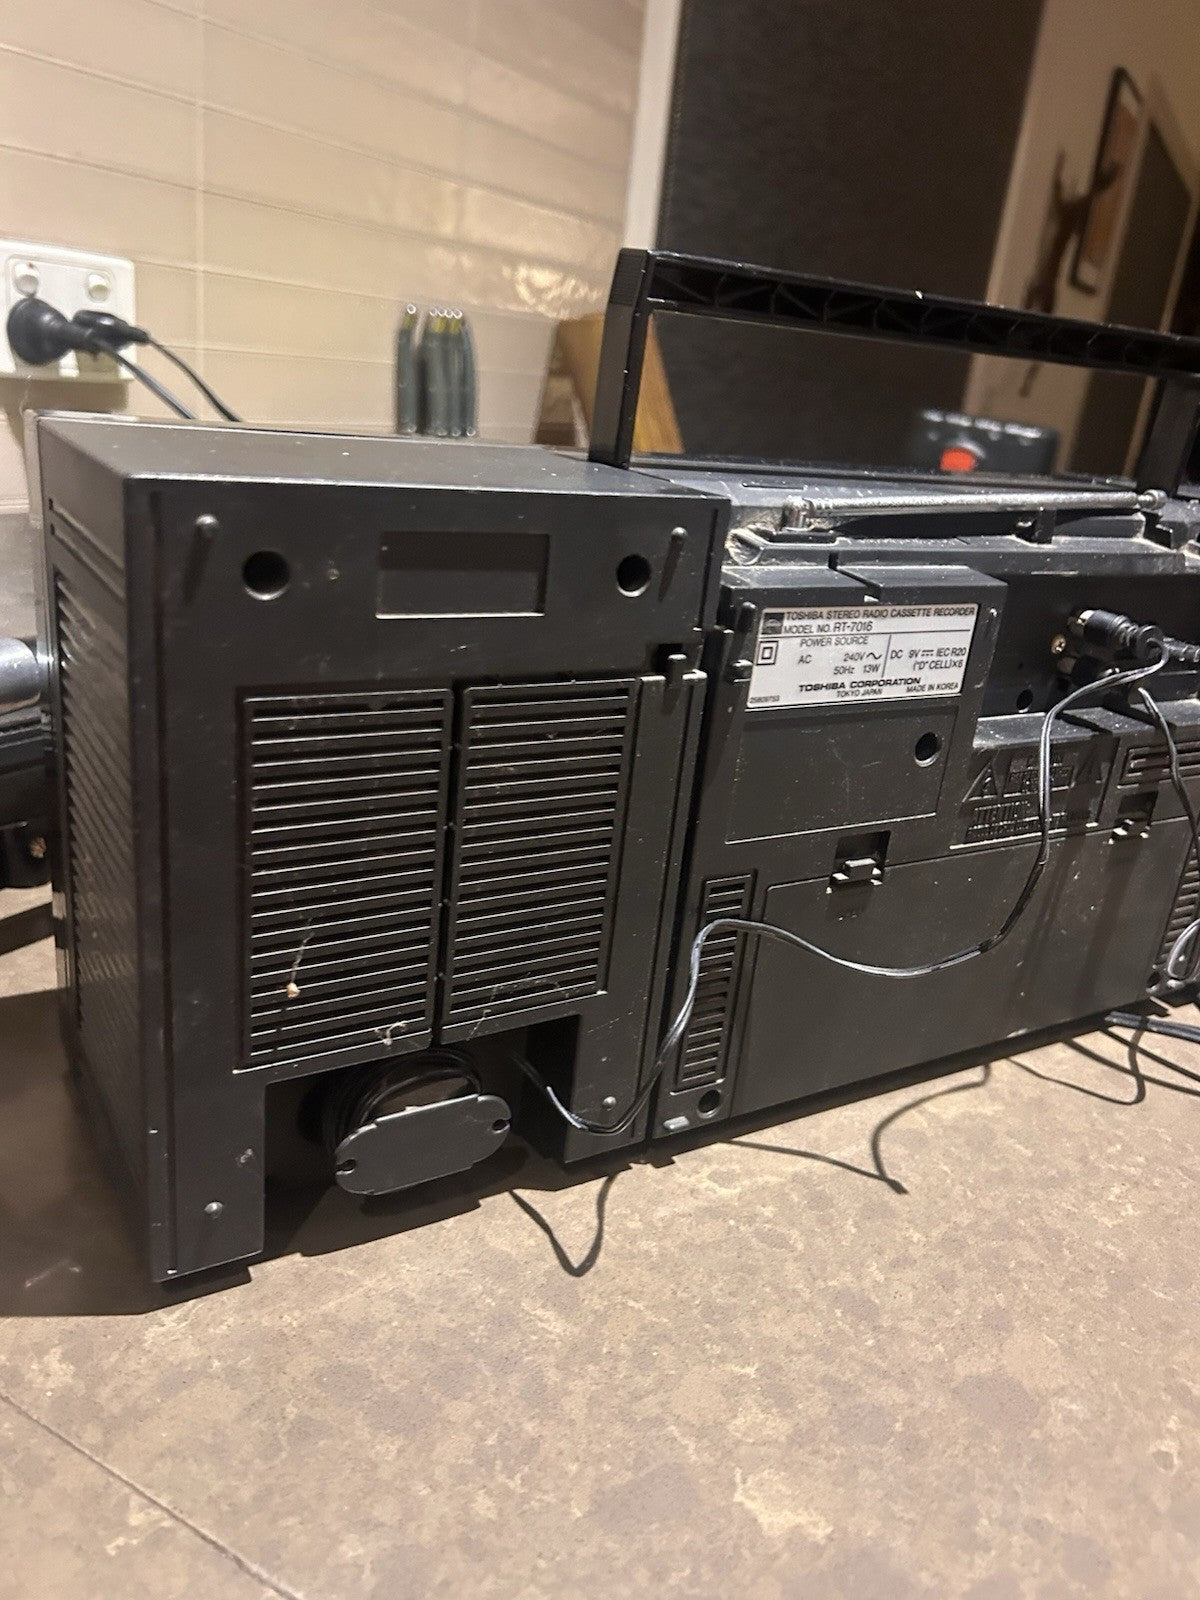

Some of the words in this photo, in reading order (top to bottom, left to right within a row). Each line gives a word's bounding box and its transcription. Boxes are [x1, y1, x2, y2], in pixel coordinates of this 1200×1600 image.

[786, 611, 823, 620] TOSHIBA
[826, 610, 860, 619] STEREO
[863, 609, 889, 619] RADIO
[890, 607, 931, 617] CASSETTE
[933, 607, 975, 617] RECORDER
[784, 624, 814, 634] MODEL
[833, 621, 873, 633] RT-7016
[800, 637, 832, 647] POWER
[834, 636, 868, 646] SOURCE
[798, 654, 812, 664] AC
[890, 649, 903, 659] DC
[936, 648, 950, 657] IEC
[951, 647, 967, 656] R20
[833, 665, 855, 675] 50Hz
[863, 663, 881, 673] 13W
[799, 681, 846, 692] TOSHIBA
[849, 677, 921, 688] CORPORATION
[906, 683, 926, 693] MADE
[927, 683, 935, 691] IN
[936, 682, 958, 691] KOREA
[837, 689, 860, 698] TOKYO
[861, 688, 883, 696] JAPAN
